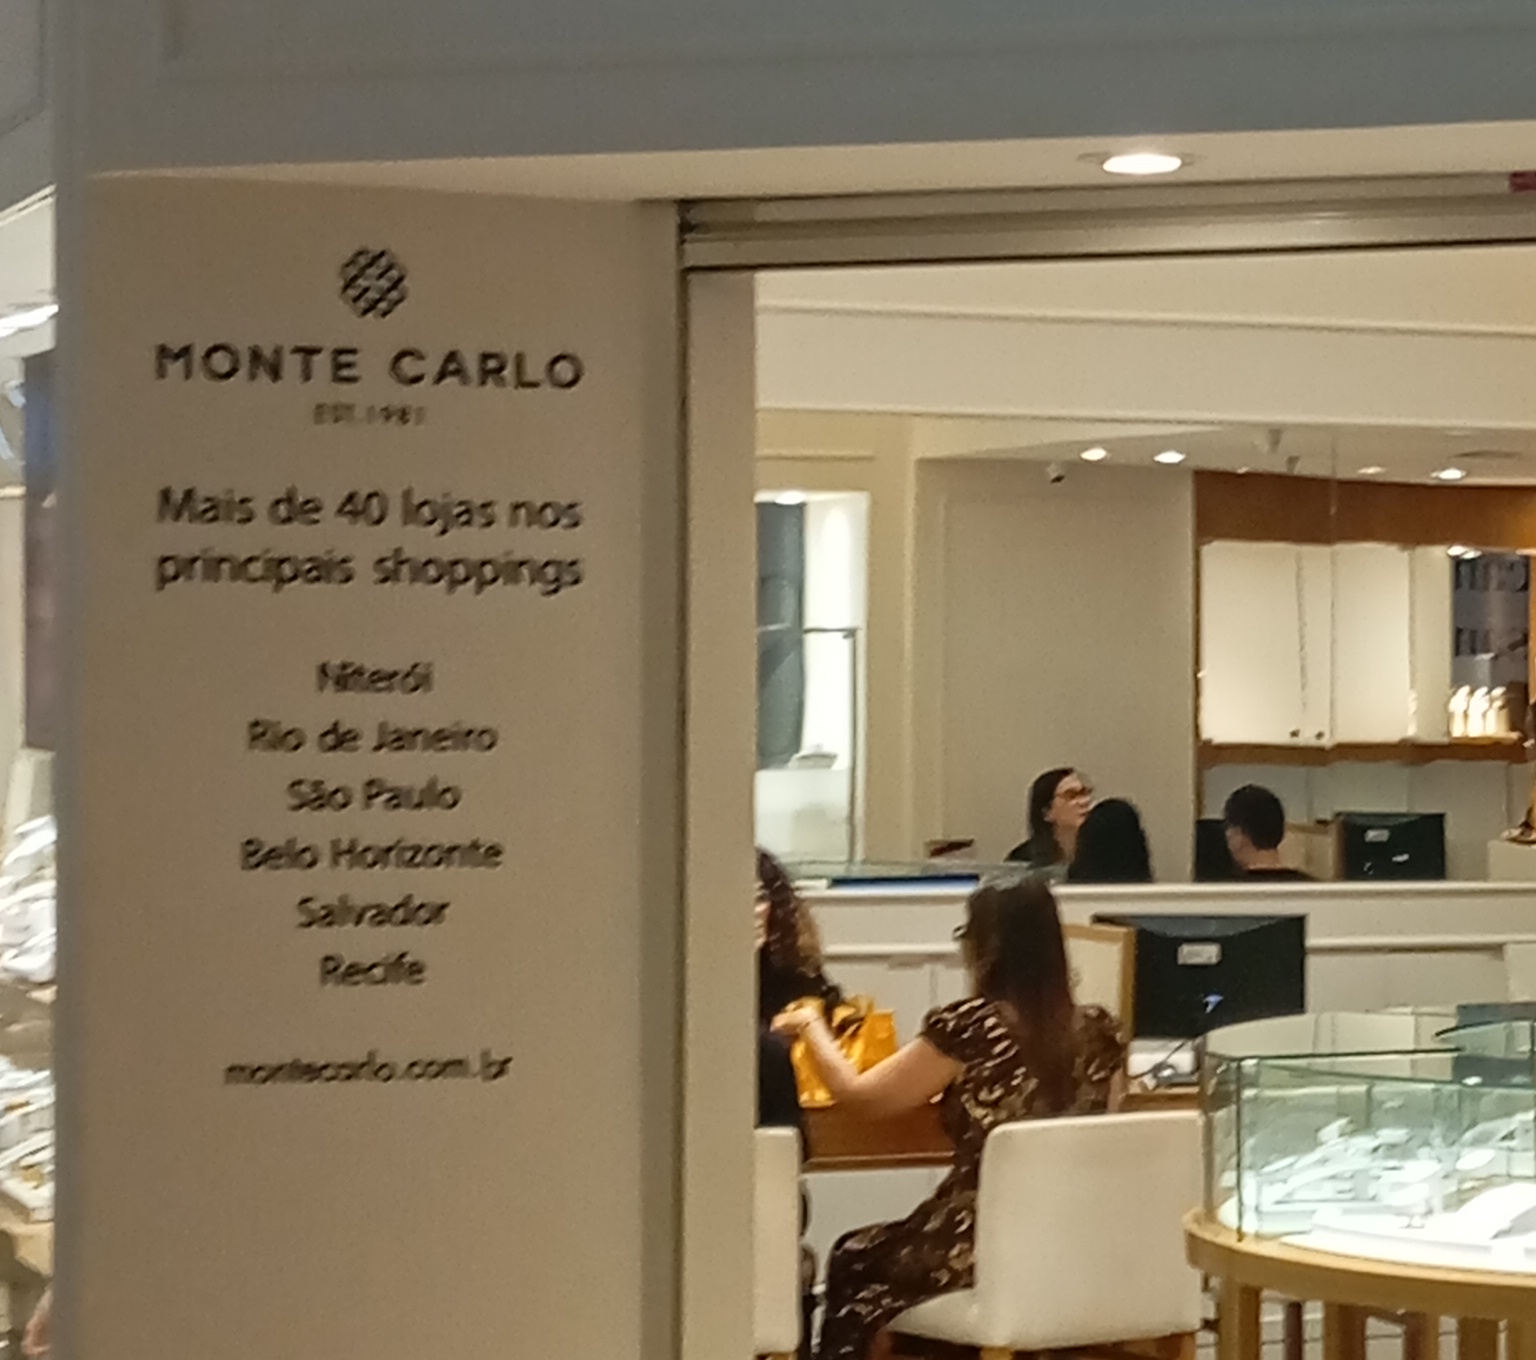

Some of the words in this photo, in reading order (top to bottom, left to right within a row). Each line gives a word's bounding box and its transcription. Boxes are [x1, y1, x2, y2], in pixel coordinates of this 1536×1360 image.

[155, 343, 361, 384] MONTE
[388, 349, 585, 389] CARLO
[156, 486, 256, 525] Mais
[267, 485, 324, 526] de
[335, 490, 388, 527] 40
[401, 486, 497, 537] lojas
[509, 499, 583, 529] nos
[155, 547, 356, 593] principais
[372, 546, 585, 597] shoppings
[316, 660, 434, 694] Niterói
[248, 718, 308, 752] Rio
[317, 719, 364, 753] de
[371, 720, 500, 753] Janeiro
[286, 778, 354, 811] São
[361, 775, 462, 811] Paulo
[241, 837, 322, 871] Belo
[329, 837, 504, 871] Horizonte
[296, 893, 451, 928] Salvador
[319, 951, 428, 986] Recife
[223, 1048, 514, 1084] montecarlo.com.br
